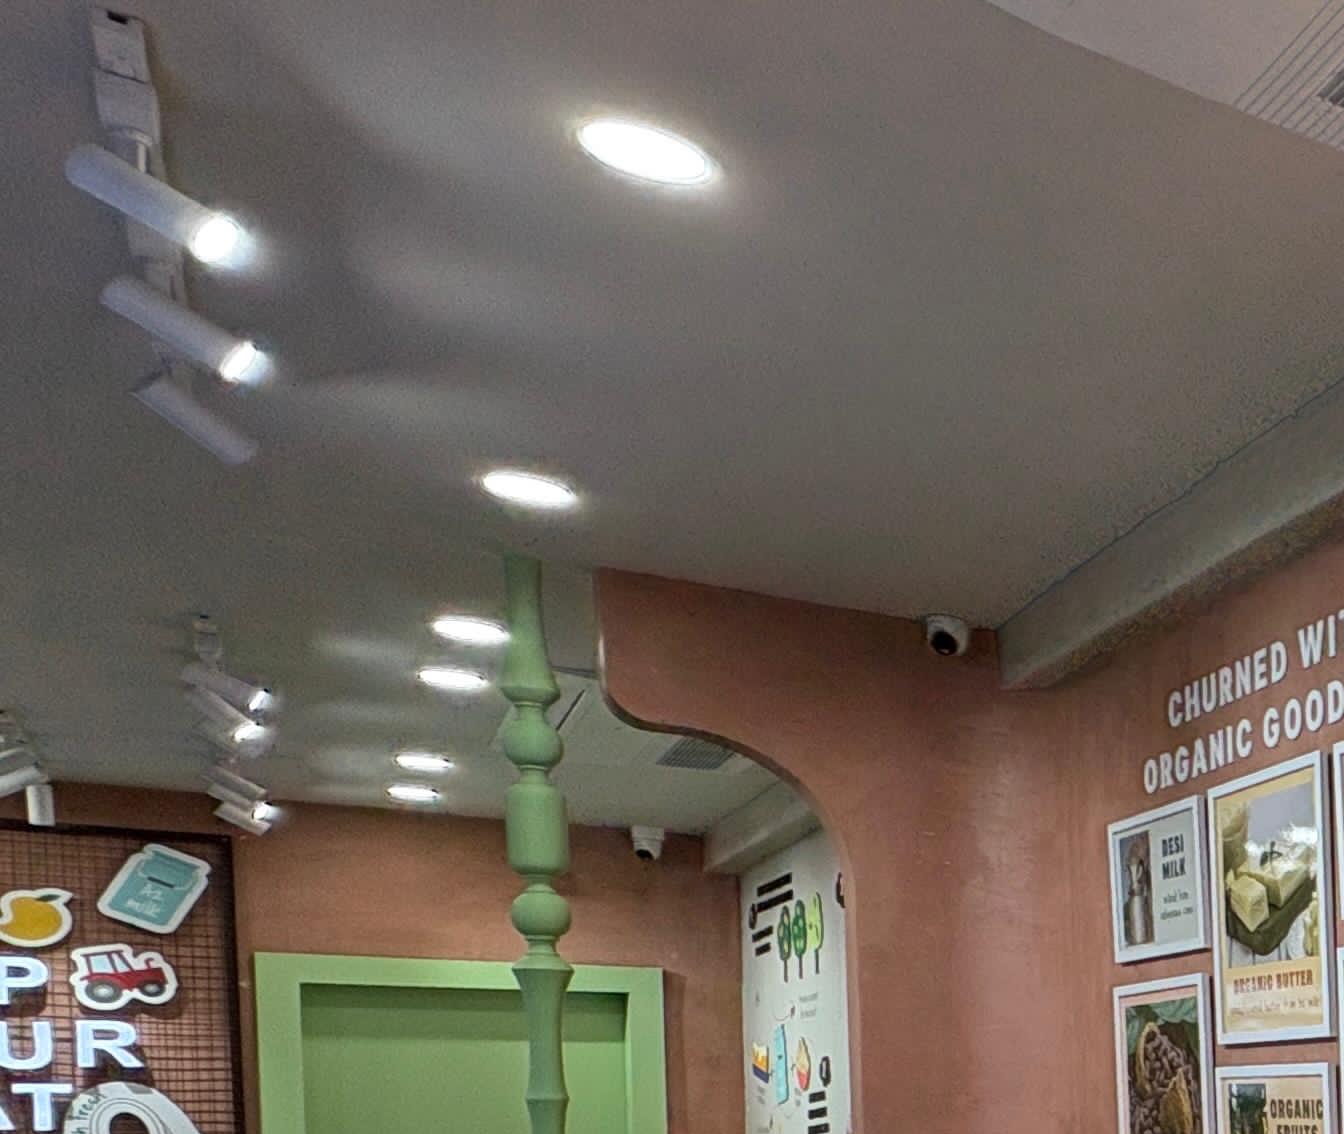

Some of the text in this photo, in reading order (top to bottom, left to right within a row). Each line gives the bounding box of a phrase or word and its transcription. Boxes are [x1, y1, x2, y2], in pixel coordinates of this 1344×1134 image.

[1168, 641, 1287, 728] CHURNED
[1143, 718, 1253, 794] ORGANIC
[1162, 833, 1184, 857] DESI
[1162, 857, 1186, 880] MILK
[1276, 969, 1313, 989] BUTTER
[1270, 1098, 1324, 1120] ORGANIC
